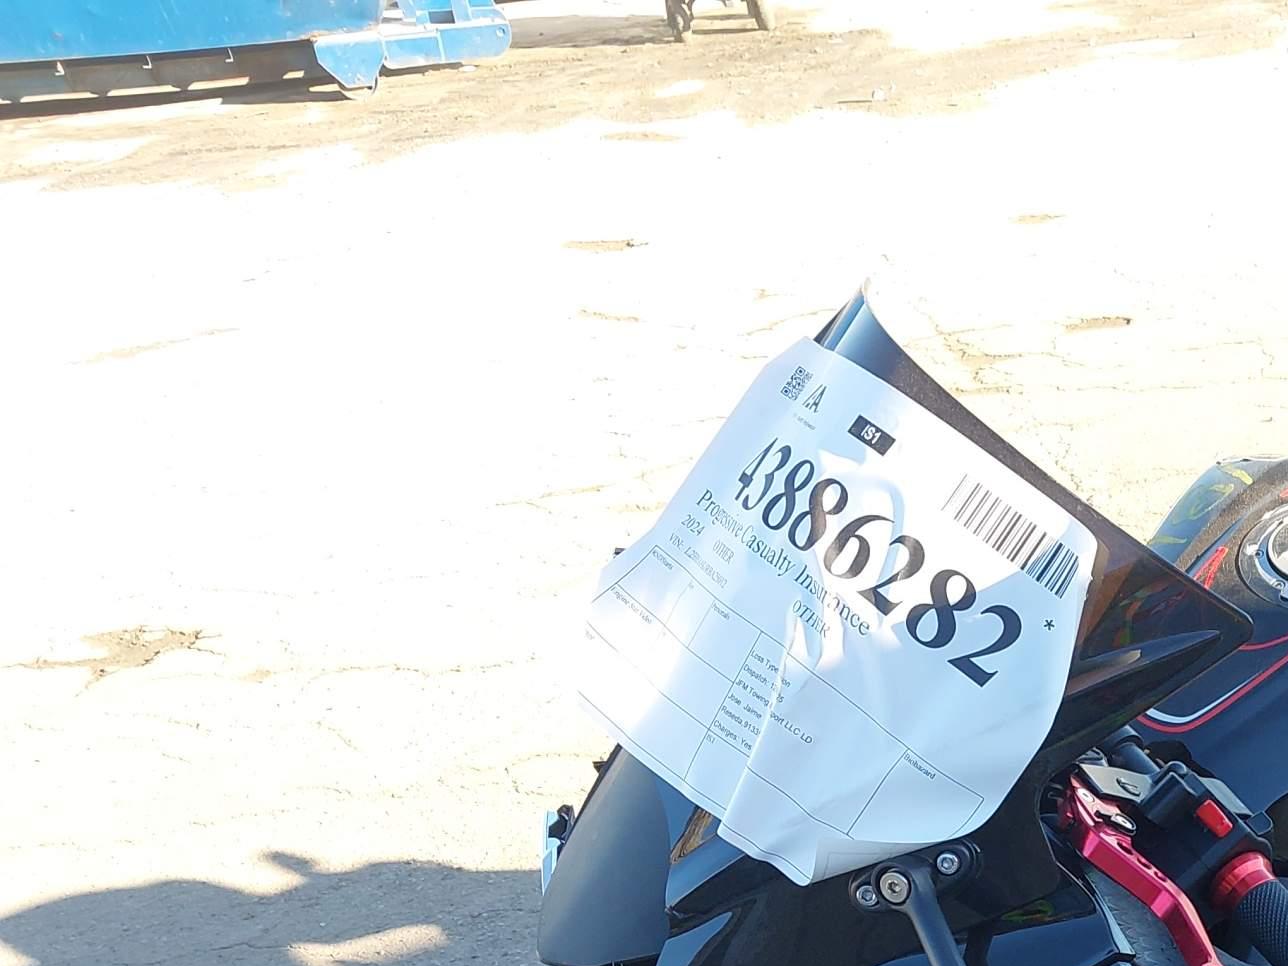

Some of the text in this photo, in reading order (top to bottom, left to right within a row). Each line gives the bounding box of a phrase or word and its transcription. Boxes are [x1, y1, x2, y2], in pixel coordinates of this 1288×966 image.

[681, 513, 831, 638] 2024 OTHER OTHER
[734, 437, 1022, 688] 43886282
[741, 524, 796, 577] Casualty
[794, 565, 870, 636] Insurance
[750, 650, 765, 664] Loss
[743, 664, 770, 686] Dispatch:
[727, 693, 742, 706] Jose
[735, 679, 750, 692] JFM
[748, 687, 770, 707] Towing
[784, 723, 801, 737] LLC
[800, 732, 814, 745] LD
[740, 737, 752, 751] Yes
[903, 753, 936, 780] Biohazard
